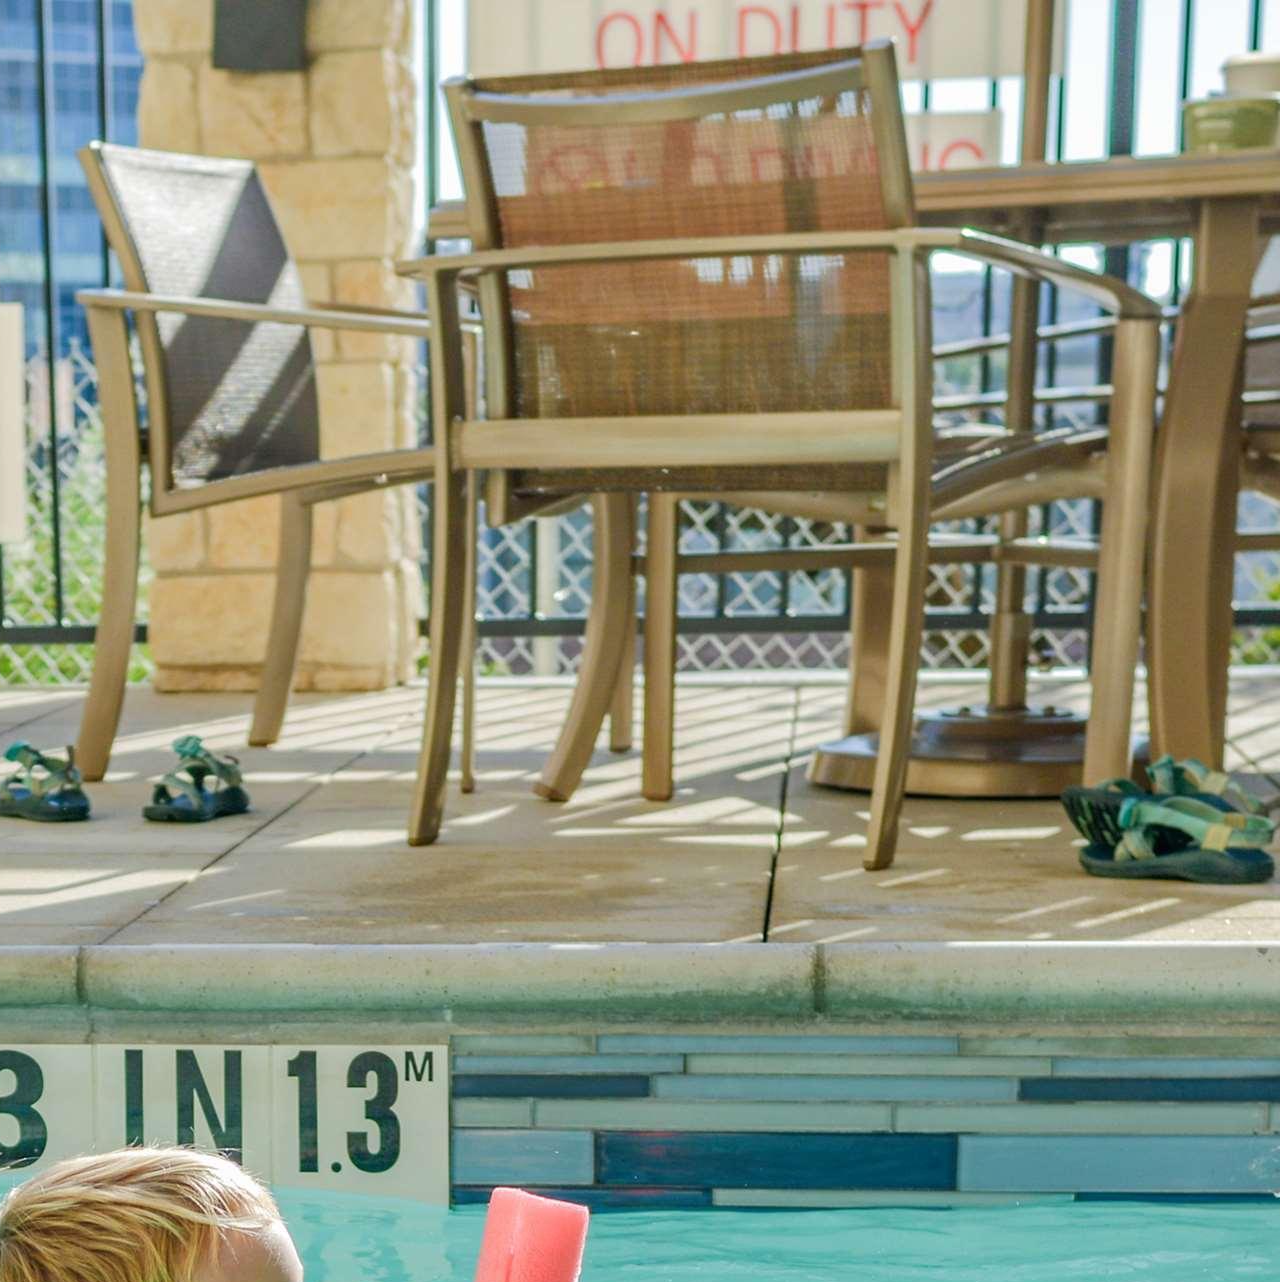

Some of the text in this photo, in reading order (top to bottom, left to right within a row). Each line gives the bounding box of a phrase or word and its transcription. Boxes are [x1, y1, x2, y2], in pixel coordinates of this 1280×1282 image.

[595, 2, 934, 70] ON DUTY
[125, 1049, 243, 1166] IN
